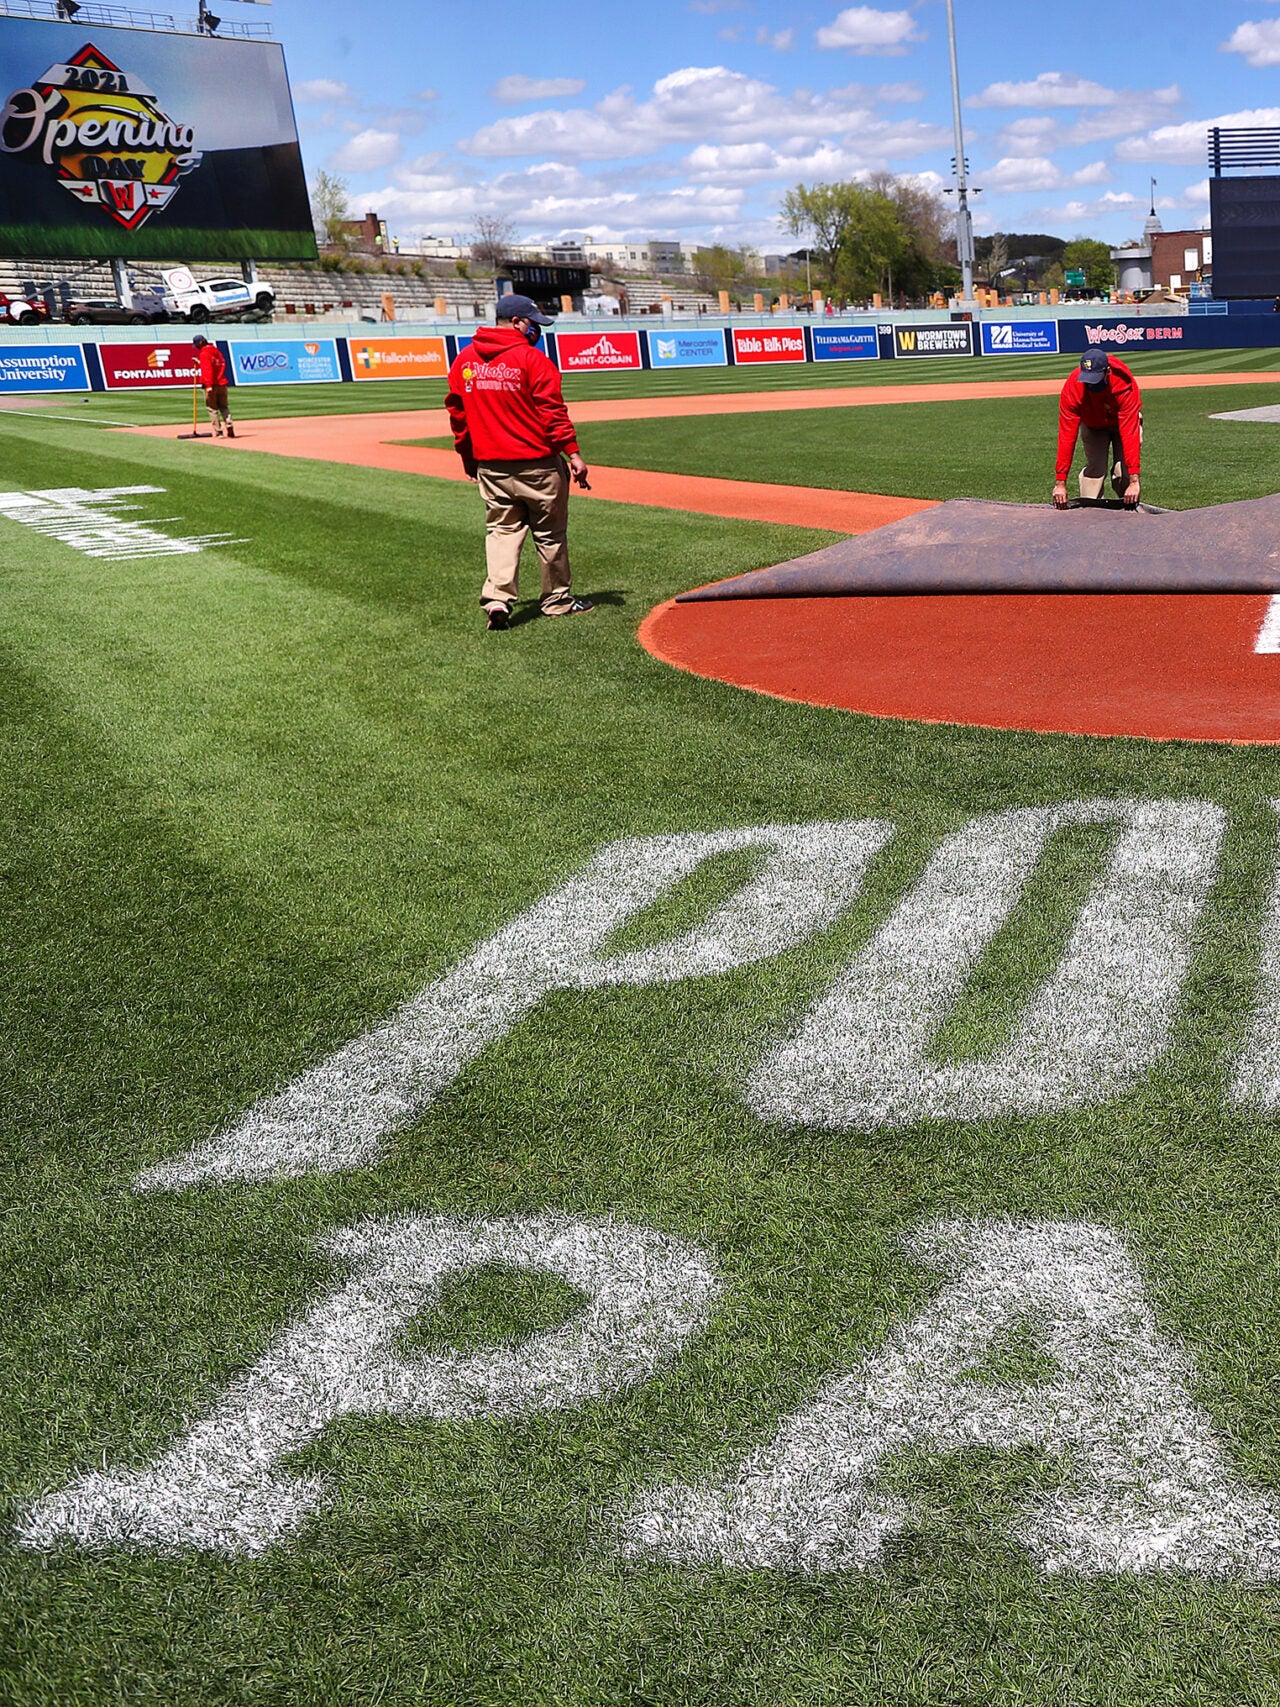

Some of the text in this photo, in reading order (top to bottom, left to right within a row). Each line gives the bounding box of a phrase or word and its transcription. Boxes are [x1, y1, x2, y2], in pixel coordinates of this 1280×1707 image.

[64, 66, 129, 92] 2021
[0, 87, 203, 168] Opening
[82, 155, 147, 179] DAY
[879, 326, 891, 334] 399
[916, 330, 966, 341] WORMTOWN
[1084, 324, 1183, 344] WooSox BERM
[678, 339, 718, 347] Mercantile
[737, 337, 803, 353] Table Talk Pies
[899, 332, 916, 350] W
[917, 340, 960, 350] BREWERY
[381, 351, 442, 363] fallonhealth
[679, 348, 713, 357] CENTER
[239, 353, 289, 370] WBDC
[568, 355, 632, 366] SAINT-GOBAIN
[0, 367, 66, 381] University
[113, 368, 173, 380] FONTAINE
[473, 362, 521, 381] WooSox
